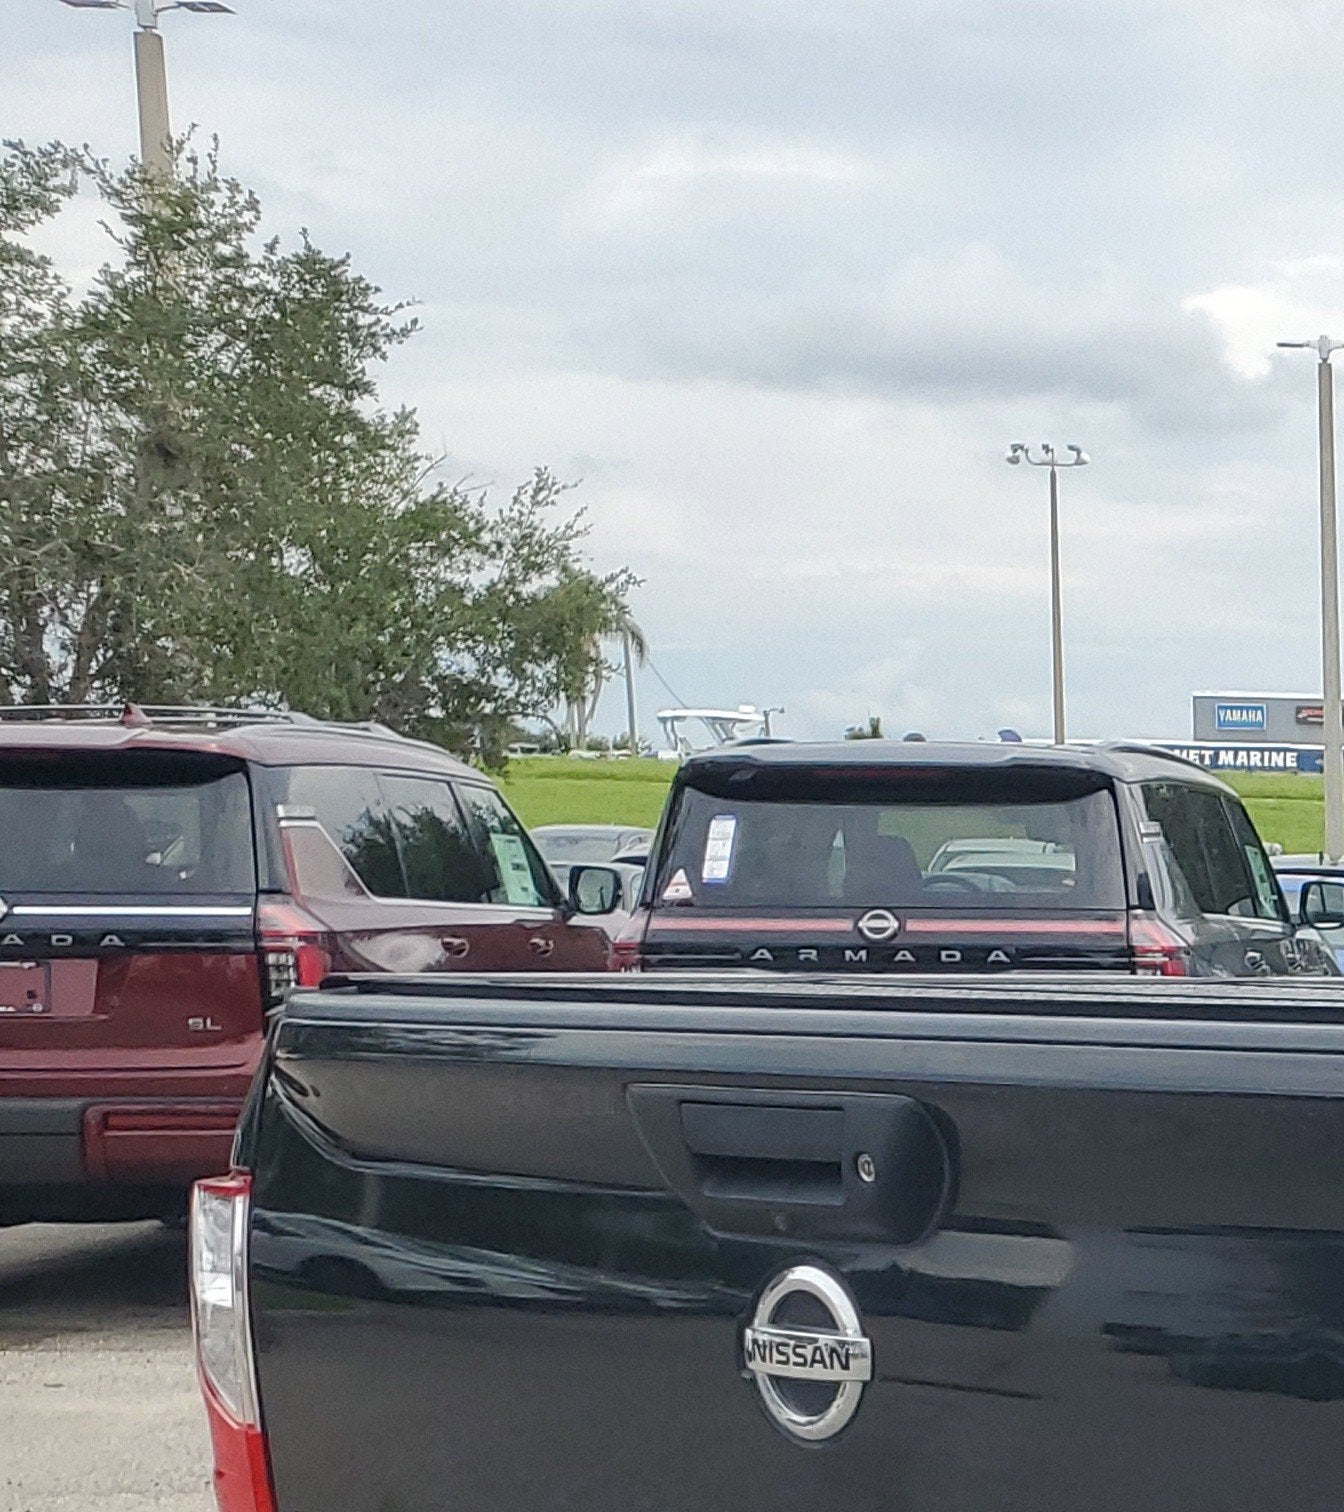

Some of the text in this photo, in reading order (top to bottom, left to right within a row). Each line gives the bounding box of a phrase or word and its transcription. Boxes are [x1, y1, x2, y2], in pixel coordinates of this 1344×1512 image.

[1218, 708, 1264, 723] YAMAHA
[1217, 750, 1298, 768] MARINE
[750, 948, 1011, 962] ARMADA
[188, 1017, 222, 1031] SL
[750, 1337, 851, 1371] NISSAN
